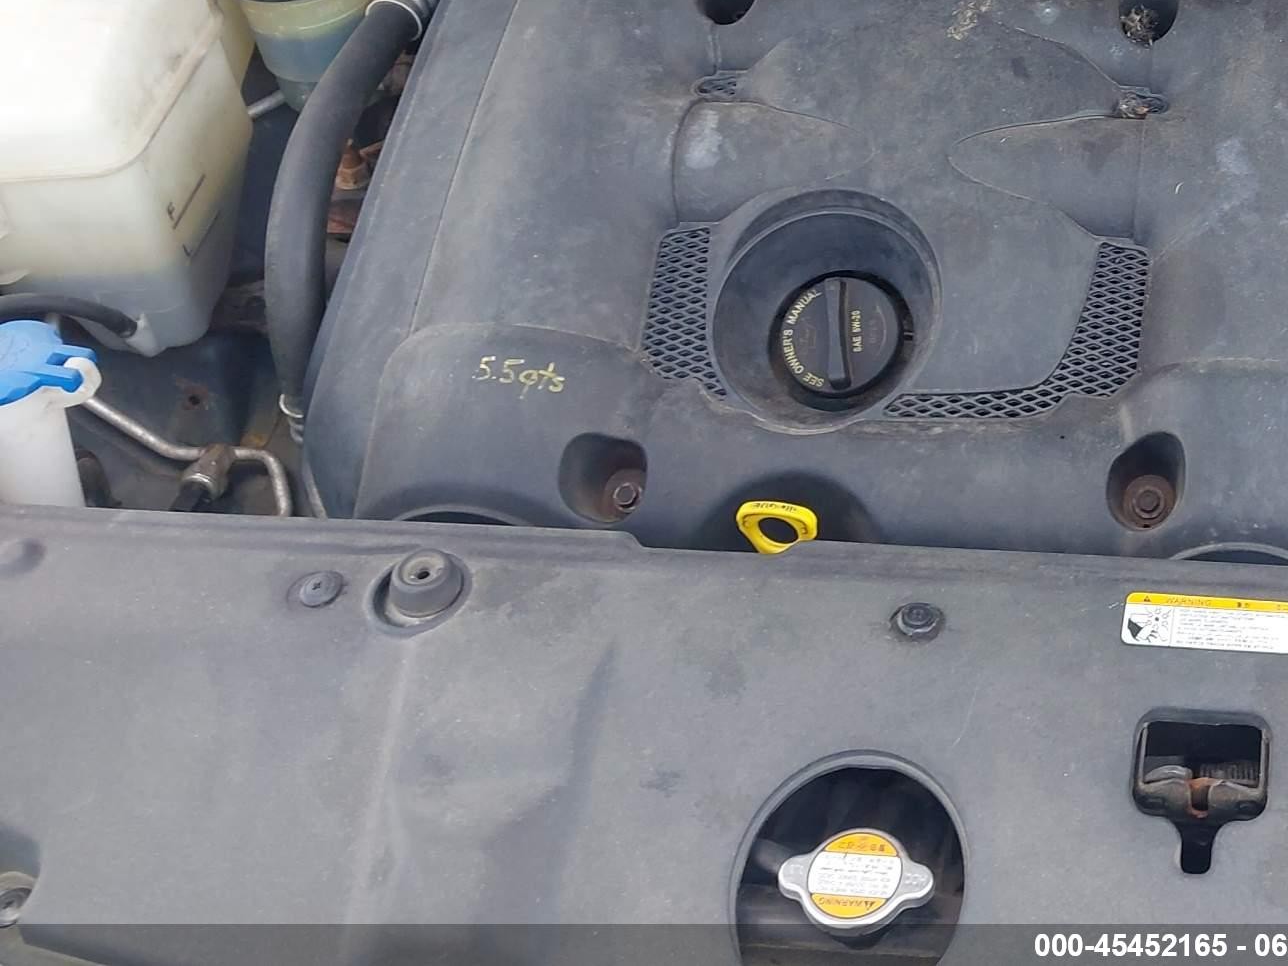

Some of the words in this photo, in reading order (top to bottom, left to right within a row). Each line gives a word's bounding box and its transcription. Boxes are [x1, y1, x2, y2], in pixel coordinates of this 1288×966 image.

[785, 288, 823, 325] MANUAL
[781, 329, 805, 375] OWNER'S
[802, 371, 826, 388] SEE
[817, 896, 864, 908] WARNING
